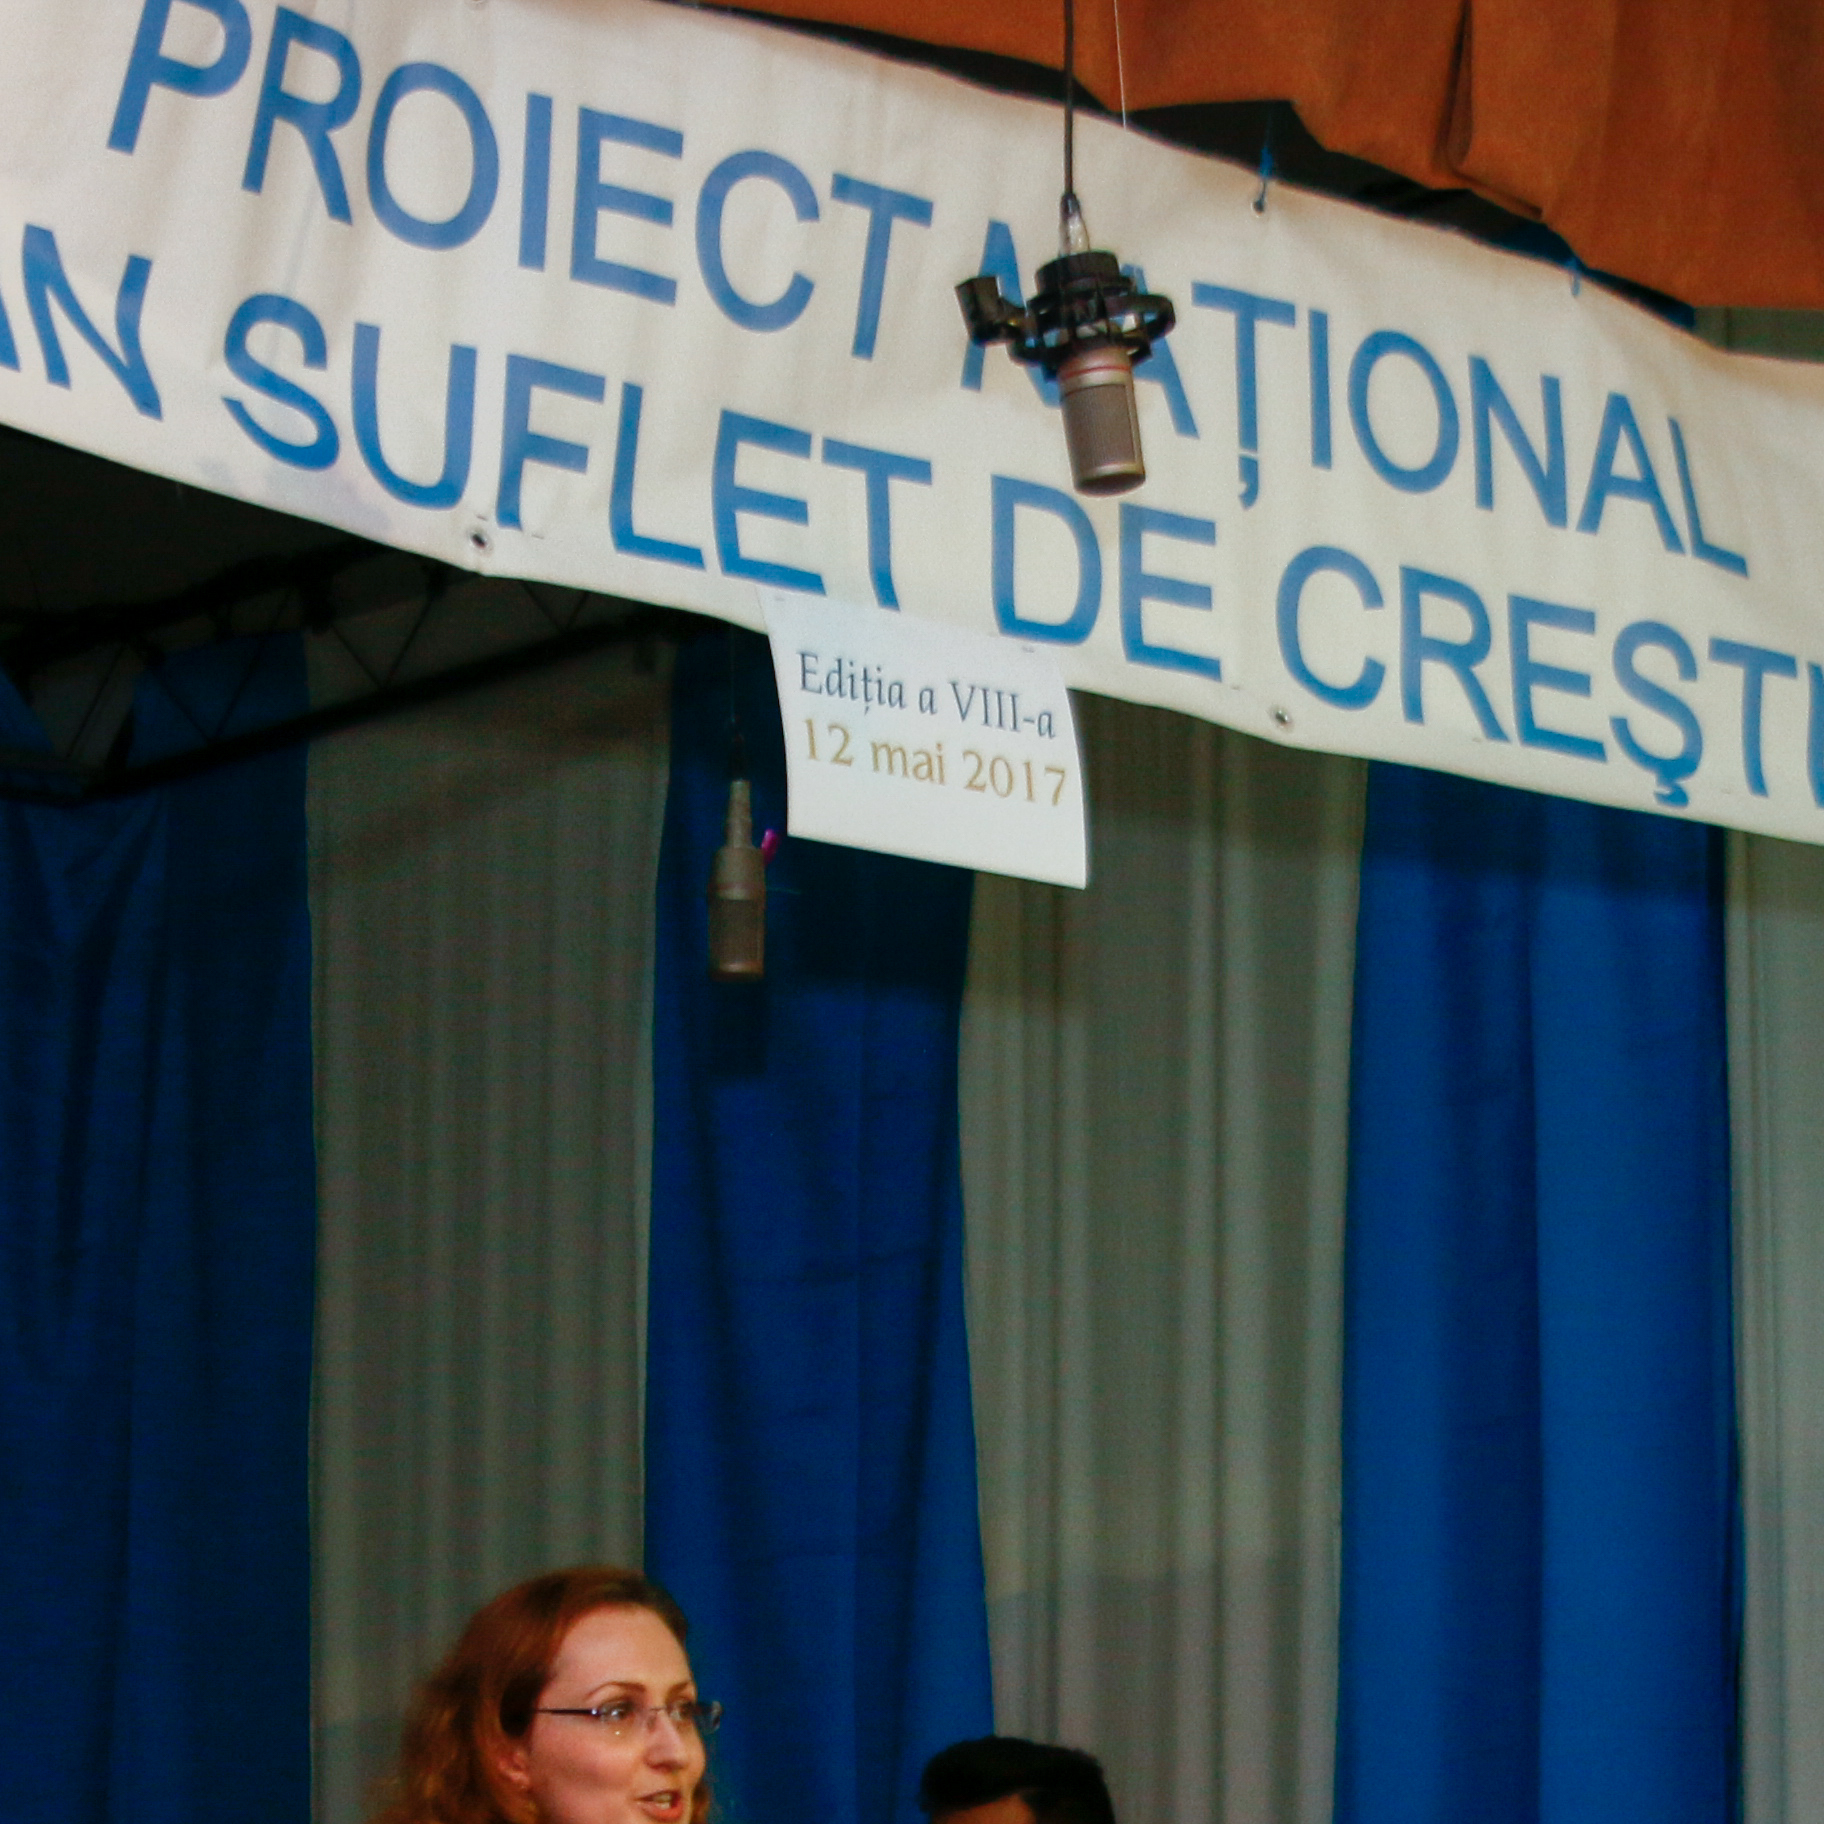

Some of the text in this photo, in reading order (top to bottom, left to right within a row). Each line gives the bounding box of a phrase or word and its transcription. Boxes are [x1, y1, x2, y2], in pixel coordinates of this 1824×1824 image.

[106, 0, 933, 361] PROIECT
[222, 292, 933, 612] SUFLET
[990, 473, 1222, 682] DE
[797, 650, 1056, 740] Ediția a VIII-a
[804, 717, 1067, 807] 12 mai 2017
